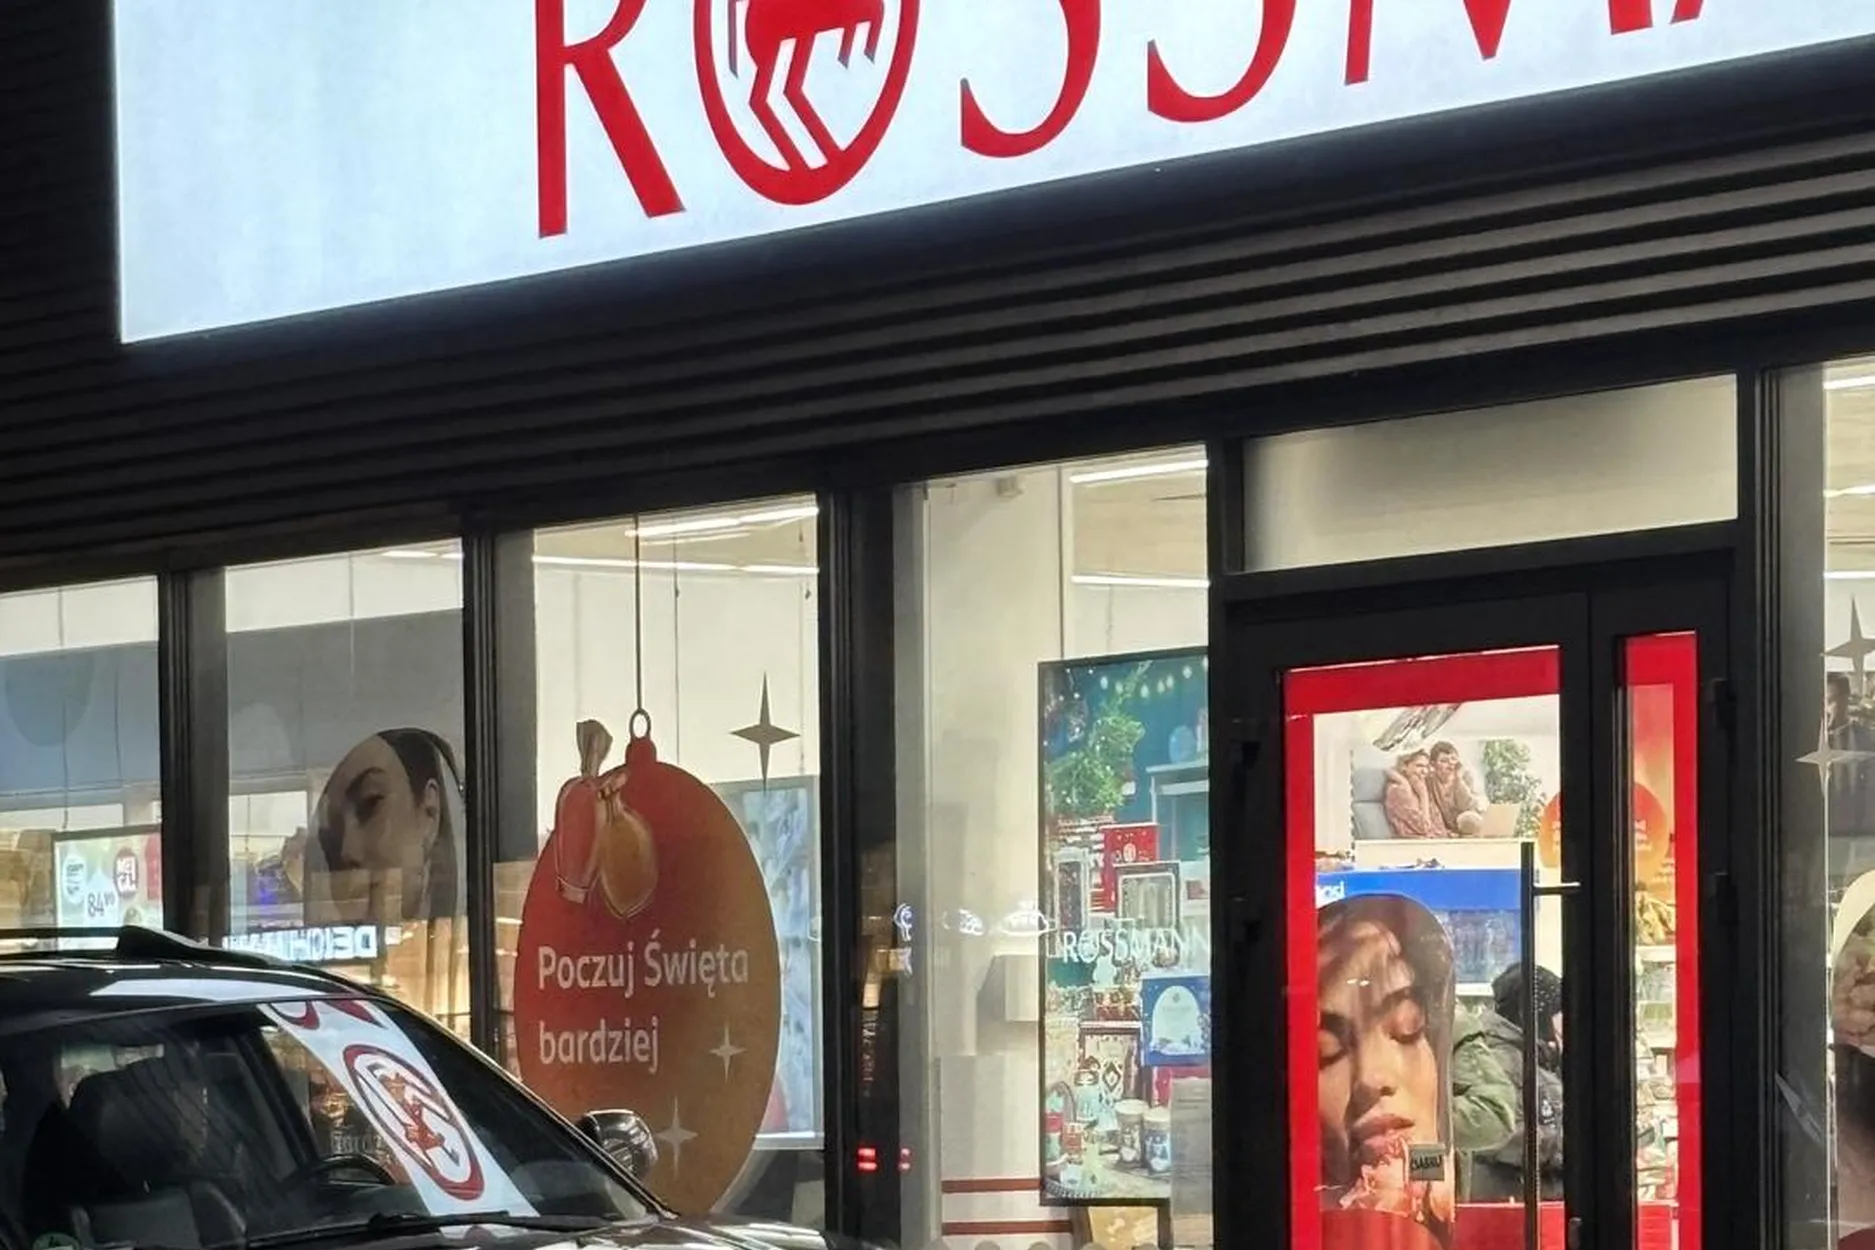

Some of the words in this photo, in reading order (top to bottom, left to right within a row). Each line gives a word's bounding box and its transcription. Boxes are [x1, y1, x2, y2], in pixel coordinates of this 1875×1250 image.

[538, 941, 634, 998] Poczuj
[644, 928, 749, 998] Święta
[538, 1015, 659, 1075] bardziej
